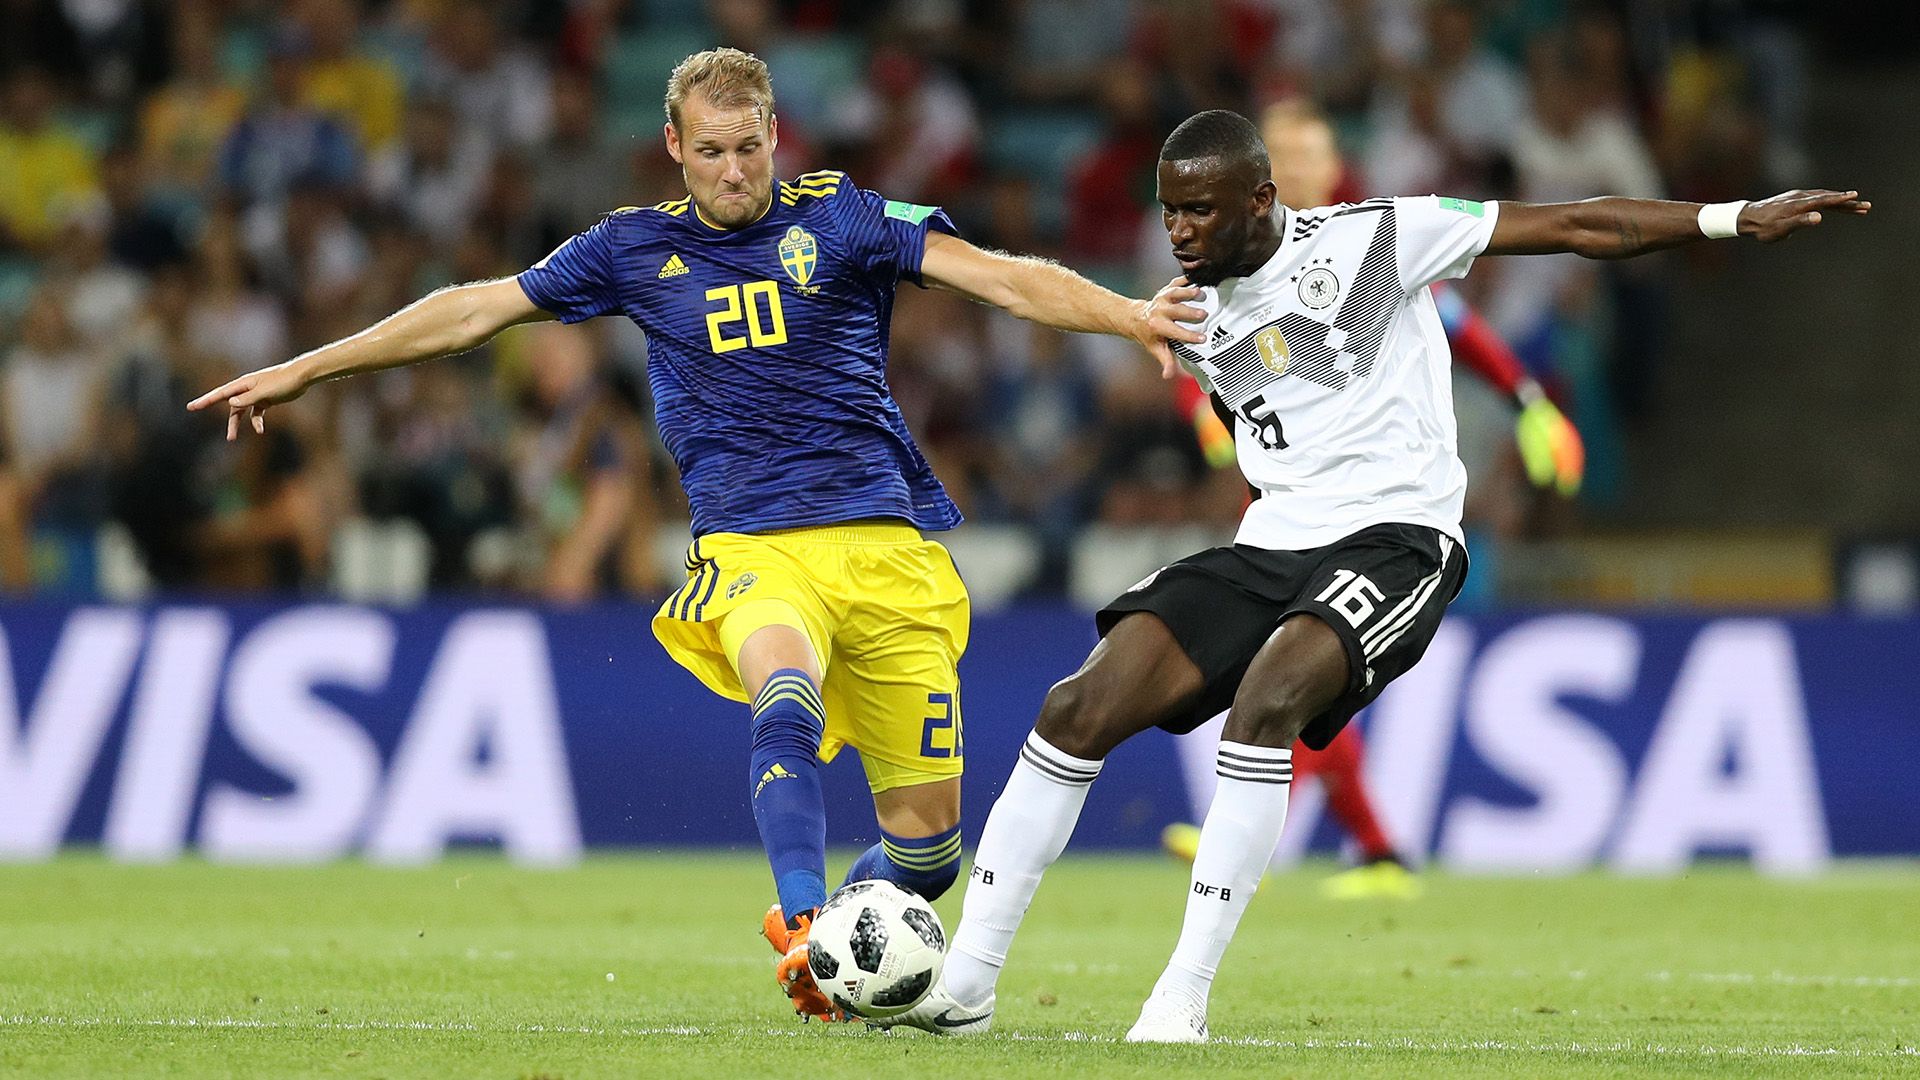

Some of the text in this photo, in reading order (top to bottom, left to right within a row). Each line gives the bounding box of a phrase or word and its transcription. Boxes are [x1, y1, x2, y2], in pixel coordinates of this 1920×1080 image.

[658, 266, 690, 279] adidas
[704, 280, 789, 354] 20
[1211, 333, 1235, 350] adidas
[1234, 394, 1290, 450] 6
[1313, 568, 1387, 630] 16
[0, 603, 583, 866] VISA
[920, 693, 963, 758] 2
[1193, 881, 1232, 902] DFB
[854, 977, 866, 1001] adidas
